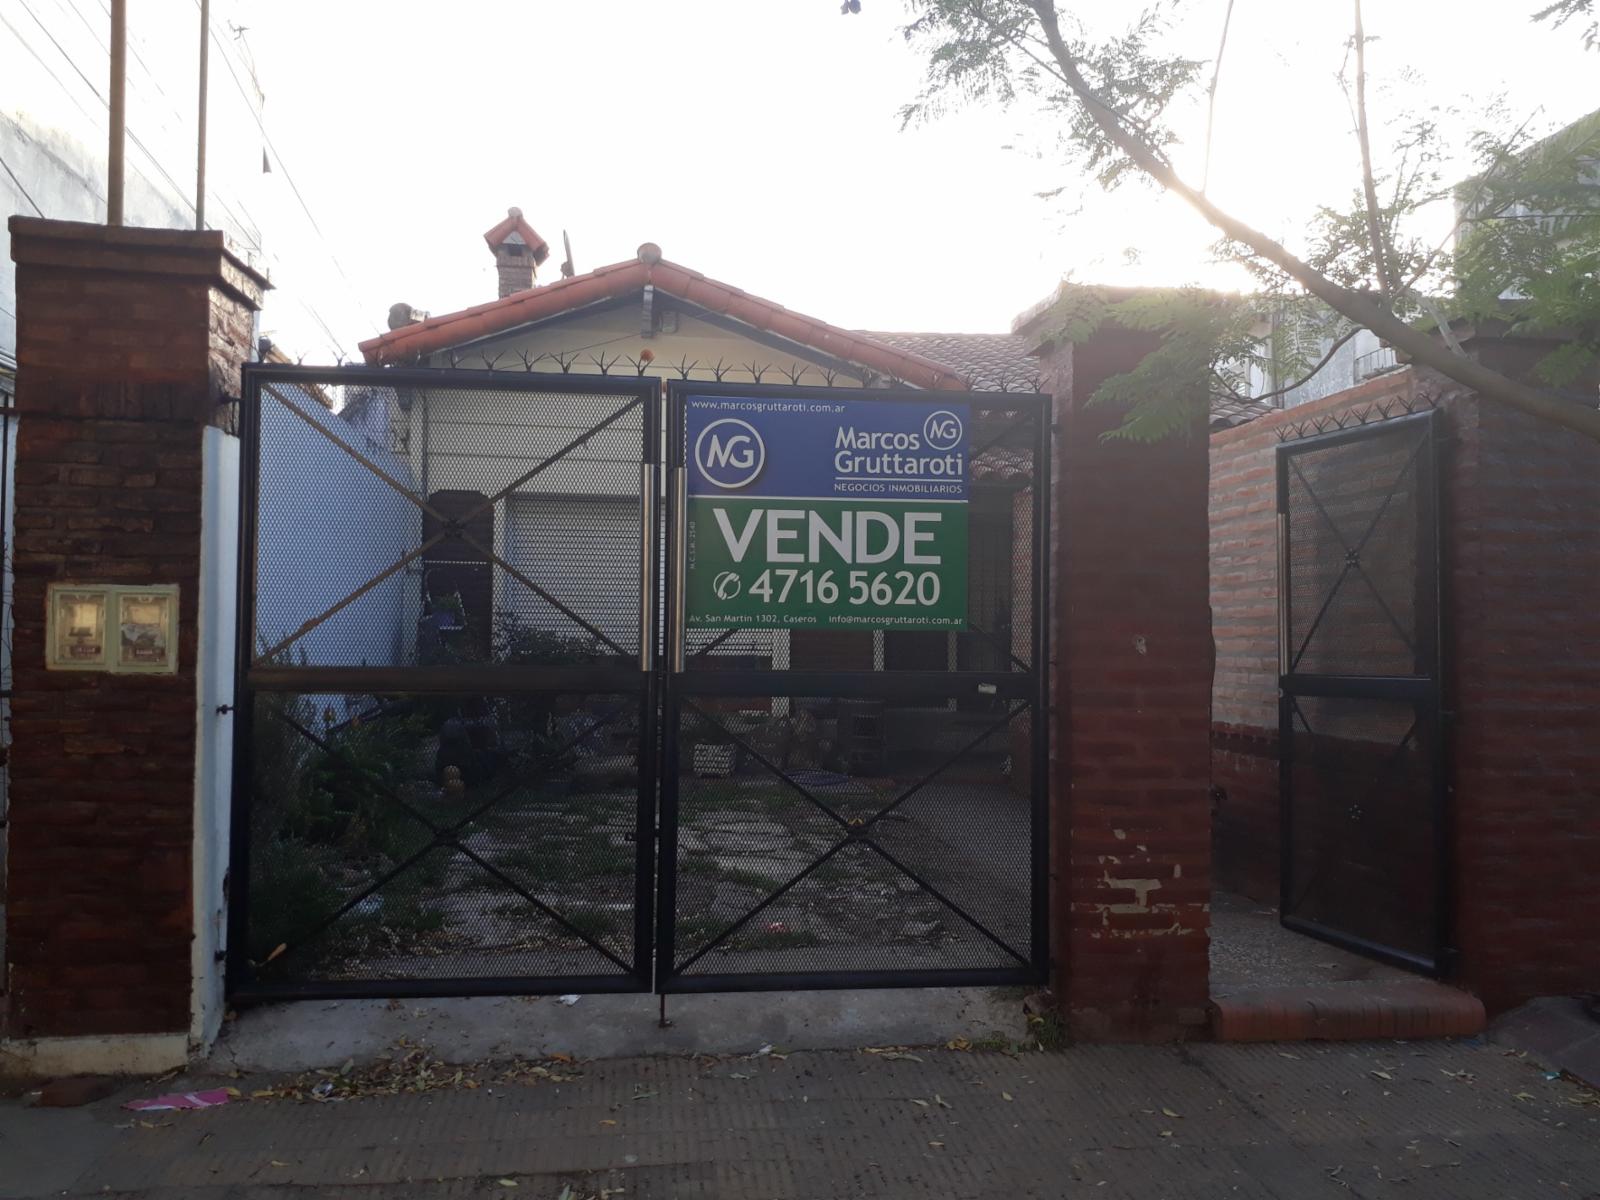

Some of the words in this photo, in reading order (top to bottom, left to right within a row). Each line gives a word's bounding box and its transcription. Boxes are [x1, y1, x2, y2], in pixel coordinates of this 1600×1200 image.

[691, 401, 845, 413] www.marcosgruttaroti.com.ar
[834, 426, 920, 450] Marcos
[834, 451, 963, 475] Gruttaroti
[834, 483, 885, 492] NEGOCIOS
[888, 484, 962, 494] INMOBILIARIOS
[713, 508, 942, 564] VENDE
[749, 569, 839, 603] 4716
[849, 571, 941, 605] 5620
[705, 614, 721, 623] San
[783, 615, 817, 624] Caseros
